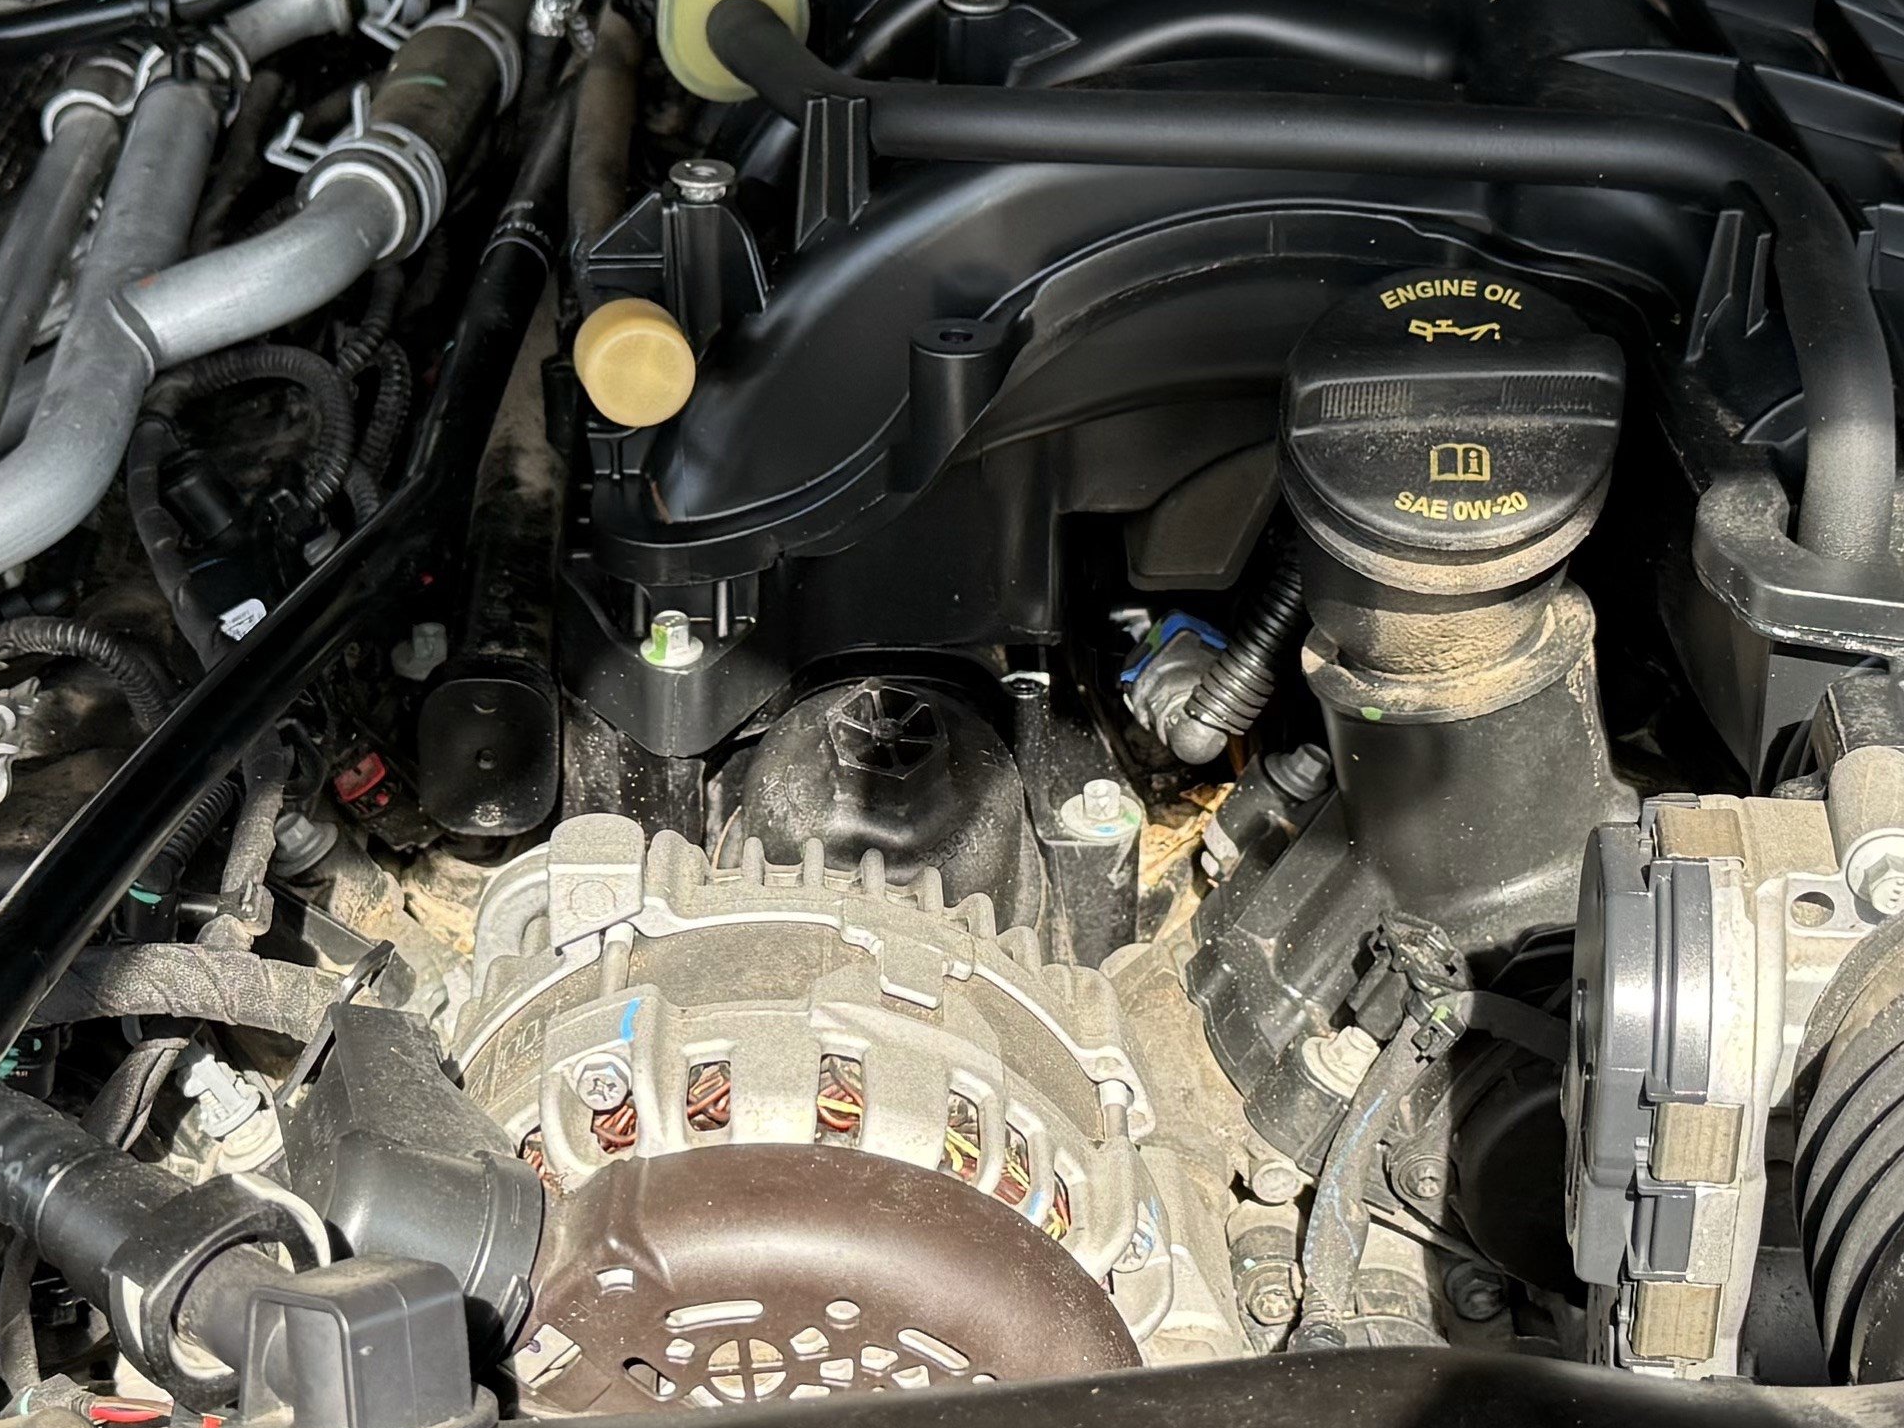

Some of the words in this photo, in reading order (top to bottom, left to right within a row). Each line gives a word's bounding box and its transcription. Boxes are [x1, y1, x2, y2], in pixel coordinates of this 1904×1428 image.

[1380, 279, 1477, 310] ENGINE
[1484, 284, 1522, 310] OIL
[1395, 491, 1448, 520] SAE
[1453, 491, 1528, 521] 0W-20
